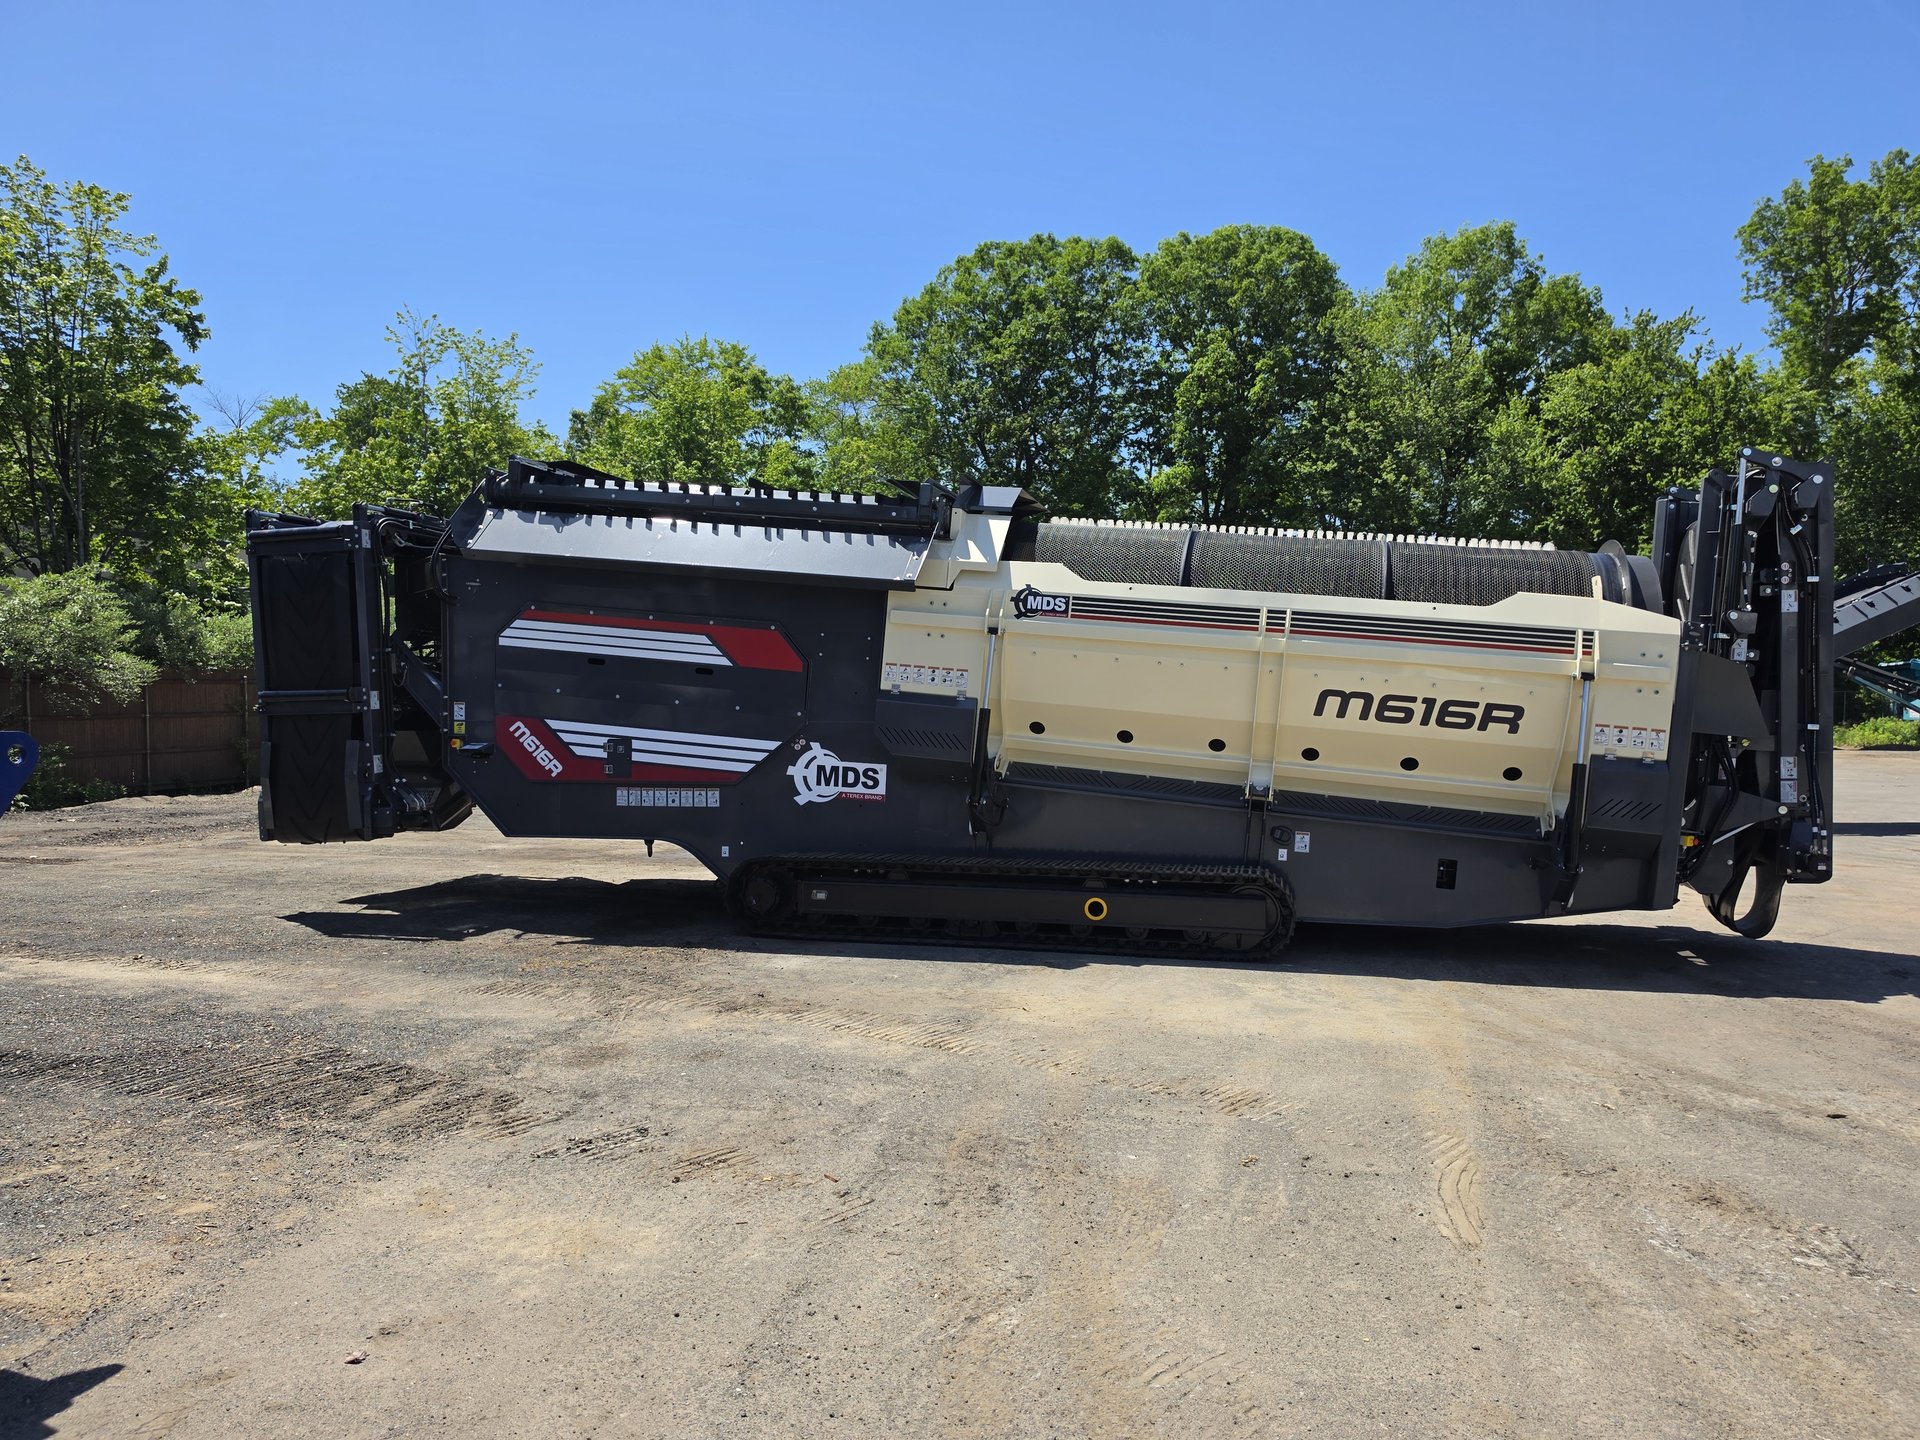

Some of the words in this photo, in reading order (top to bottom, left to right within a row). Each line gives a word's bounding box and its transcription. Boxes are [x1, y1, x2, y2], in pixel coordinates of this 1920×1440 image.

[1027, 596, 1066, 611] MDS
[1313, 689, 1525, 734] M616R
[509, 721, 563, 777] M616R
[816, 765, 880, 790] MDS
